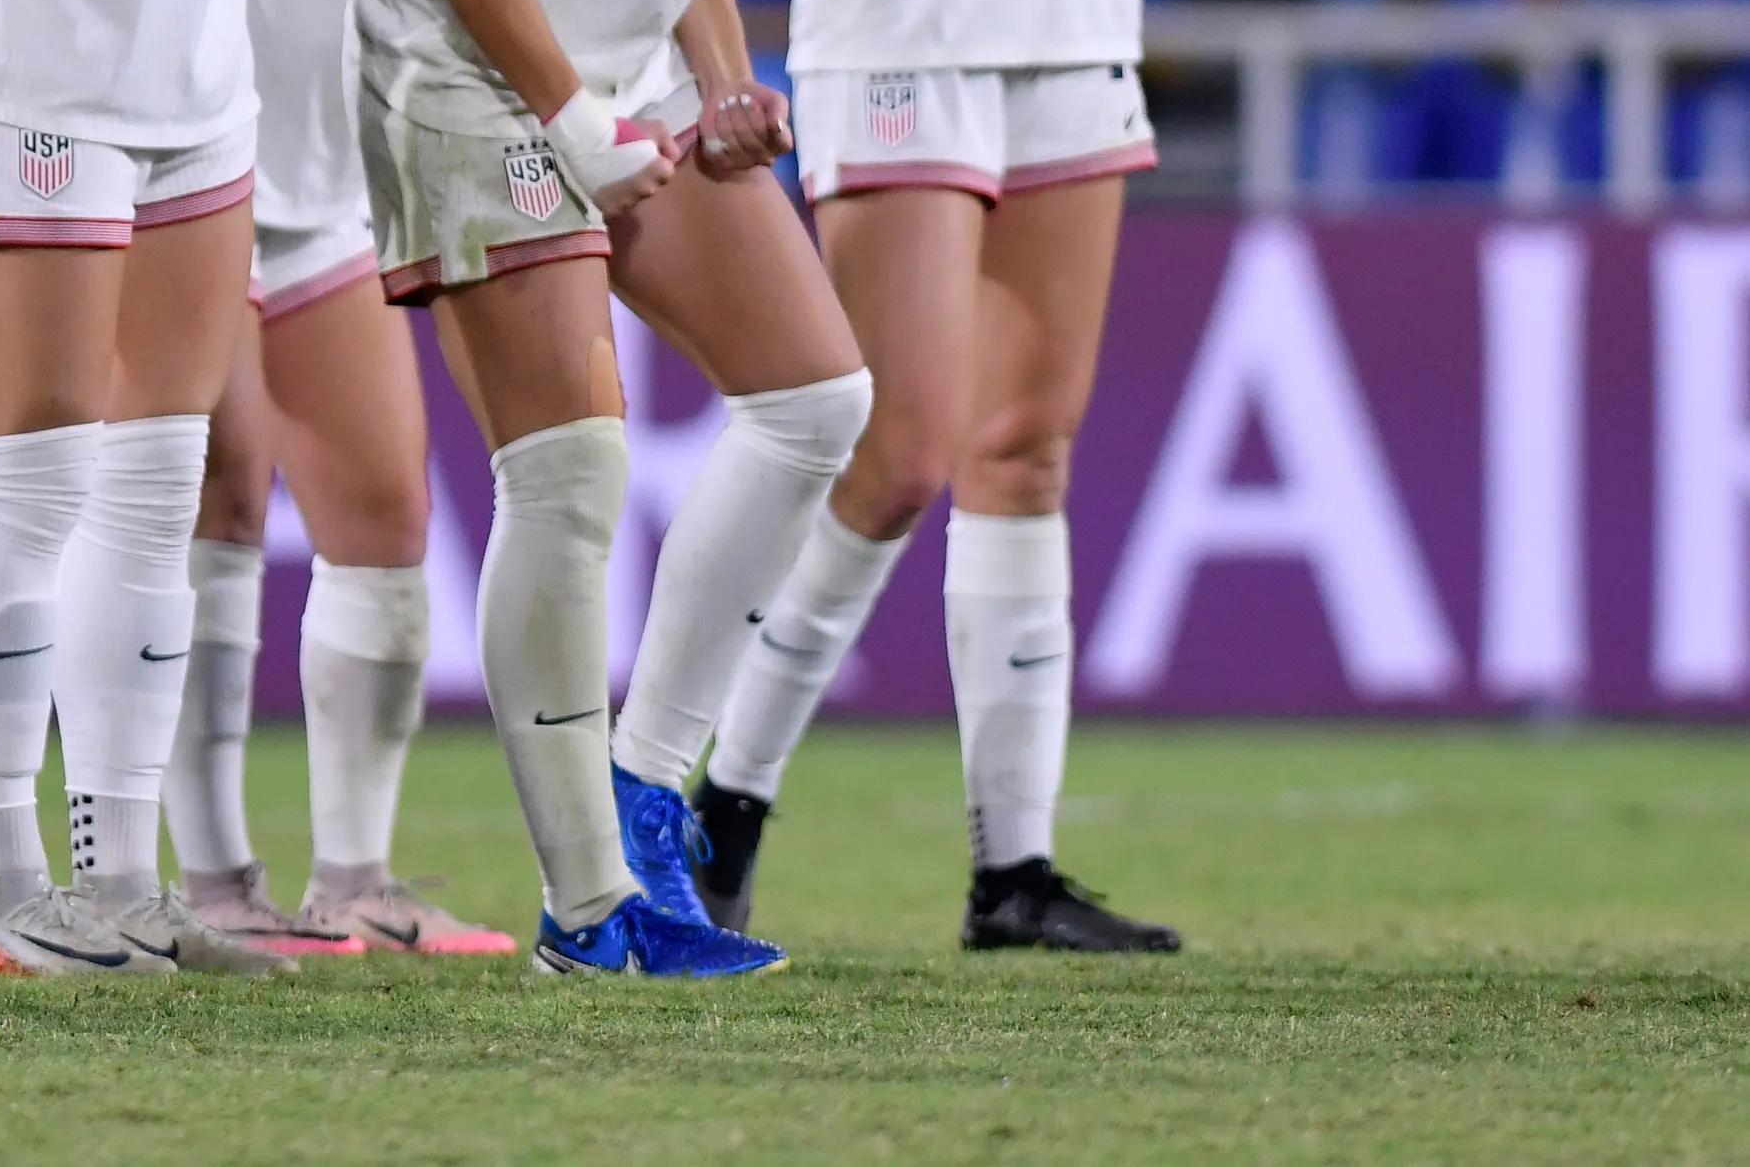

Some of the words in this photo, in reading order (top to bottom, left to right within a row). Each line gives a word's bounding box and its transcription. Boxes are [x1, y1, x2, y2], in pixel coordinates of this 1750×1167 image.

[869, 86, 911, 110] USA
[24, 132, 68, 158] USA
[510, 155, 554, 182] USA
